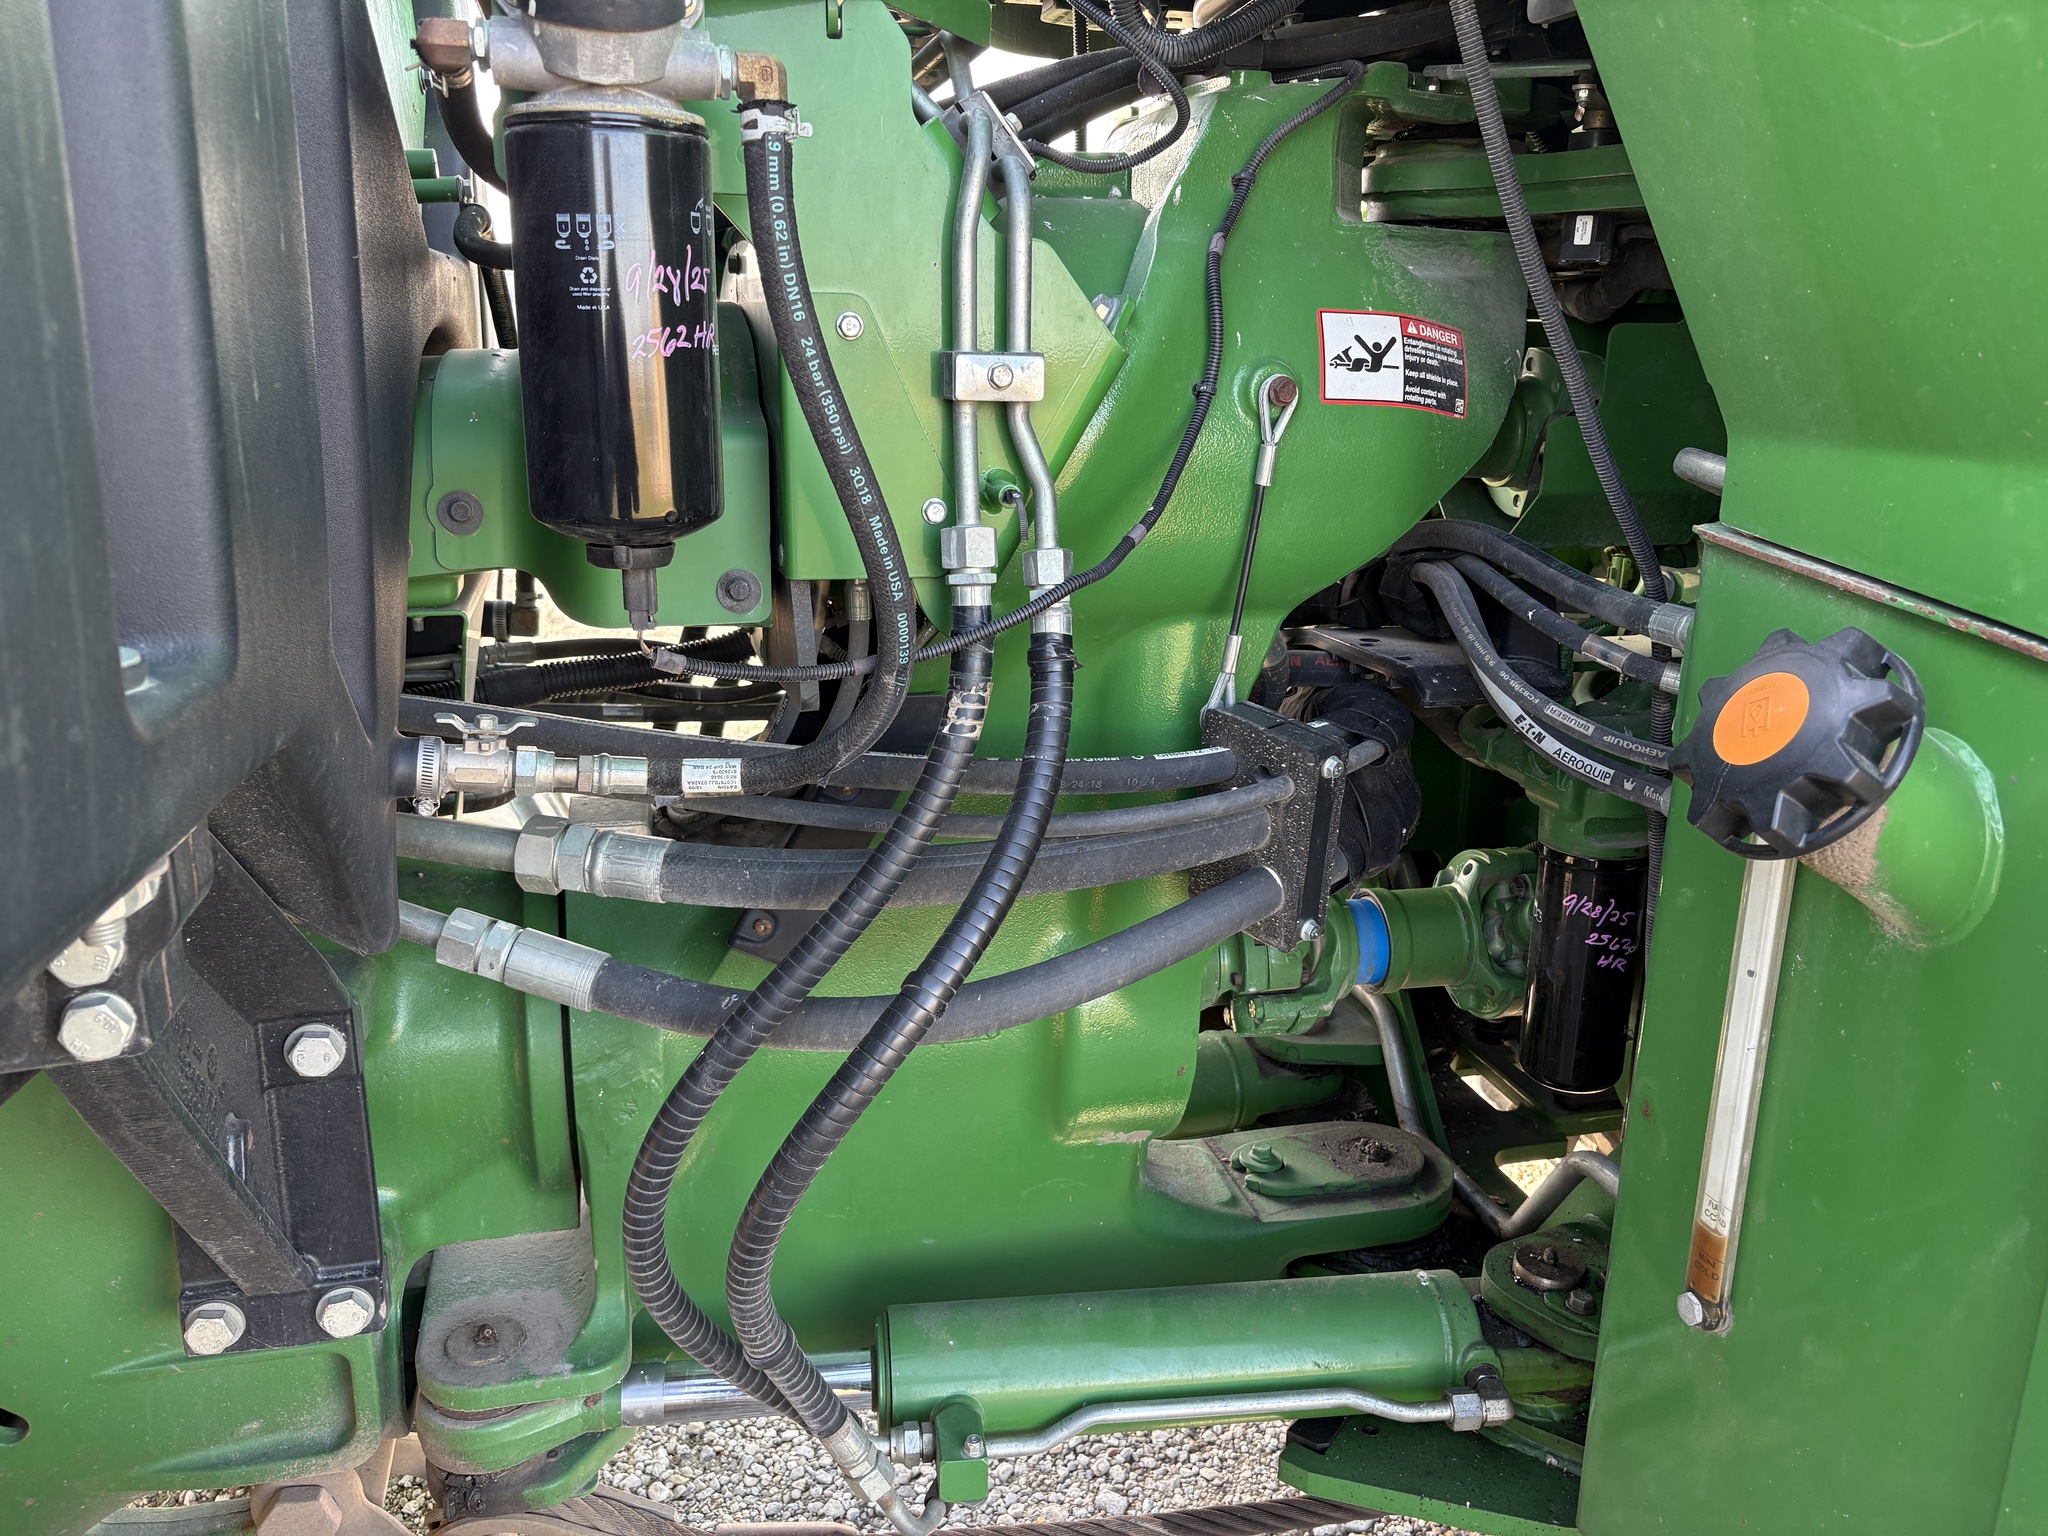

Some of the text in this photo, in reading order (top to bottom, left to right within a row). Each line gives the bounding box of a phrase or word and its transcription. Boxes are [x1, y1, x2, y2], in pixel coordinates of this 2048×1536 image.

[768, 155, 780, 191] mm
[770, 195, 788, 241] (0.62
[777, 244, 794, 270] in)
[625, 244, 710, 306] 9/28/25
[784, 272, 806, 323] DN16
[632, 321, 715, 361] 2562 HR
[801, 336, 817, 359] 24
[1404, 337, 1436, 350] Entanglement
[1441, 346, 1458, 358] rotating
[1419, 324, 1458, 346] DANGER
[1404, 345, 1463, 366] driveline can cause serious
[808, 360, 825, 388] bar
[1405, 368, 1419, 379] Keep
[1426, 373, 1441, 383] shields
[1404, 394, 1424, 405] rotating
[1405, 385, 1447, 400] Avoid contact with
[818, 388, 841, 425] (350
[831, 425, 854, 456] psi)
[850, 465, 873, 506] 3Q18
[868, 516, 889, 556] Made
[883, 554, 893, 570] in
[888, 570, 904, 602] USA
[1549, 706, 1590, 732] BRUISER
[1602, 735, 1667, 758] AEROQUIP
[1553, 748, 1612, 782] AEROQUIP
[1562, 894, 1635, 927] 9/28/25
[1585, 933, 1631, 951] 2562
[1597, 955, 1628, 972] HR
[1694, 1260, 1719, 1281] COLD
